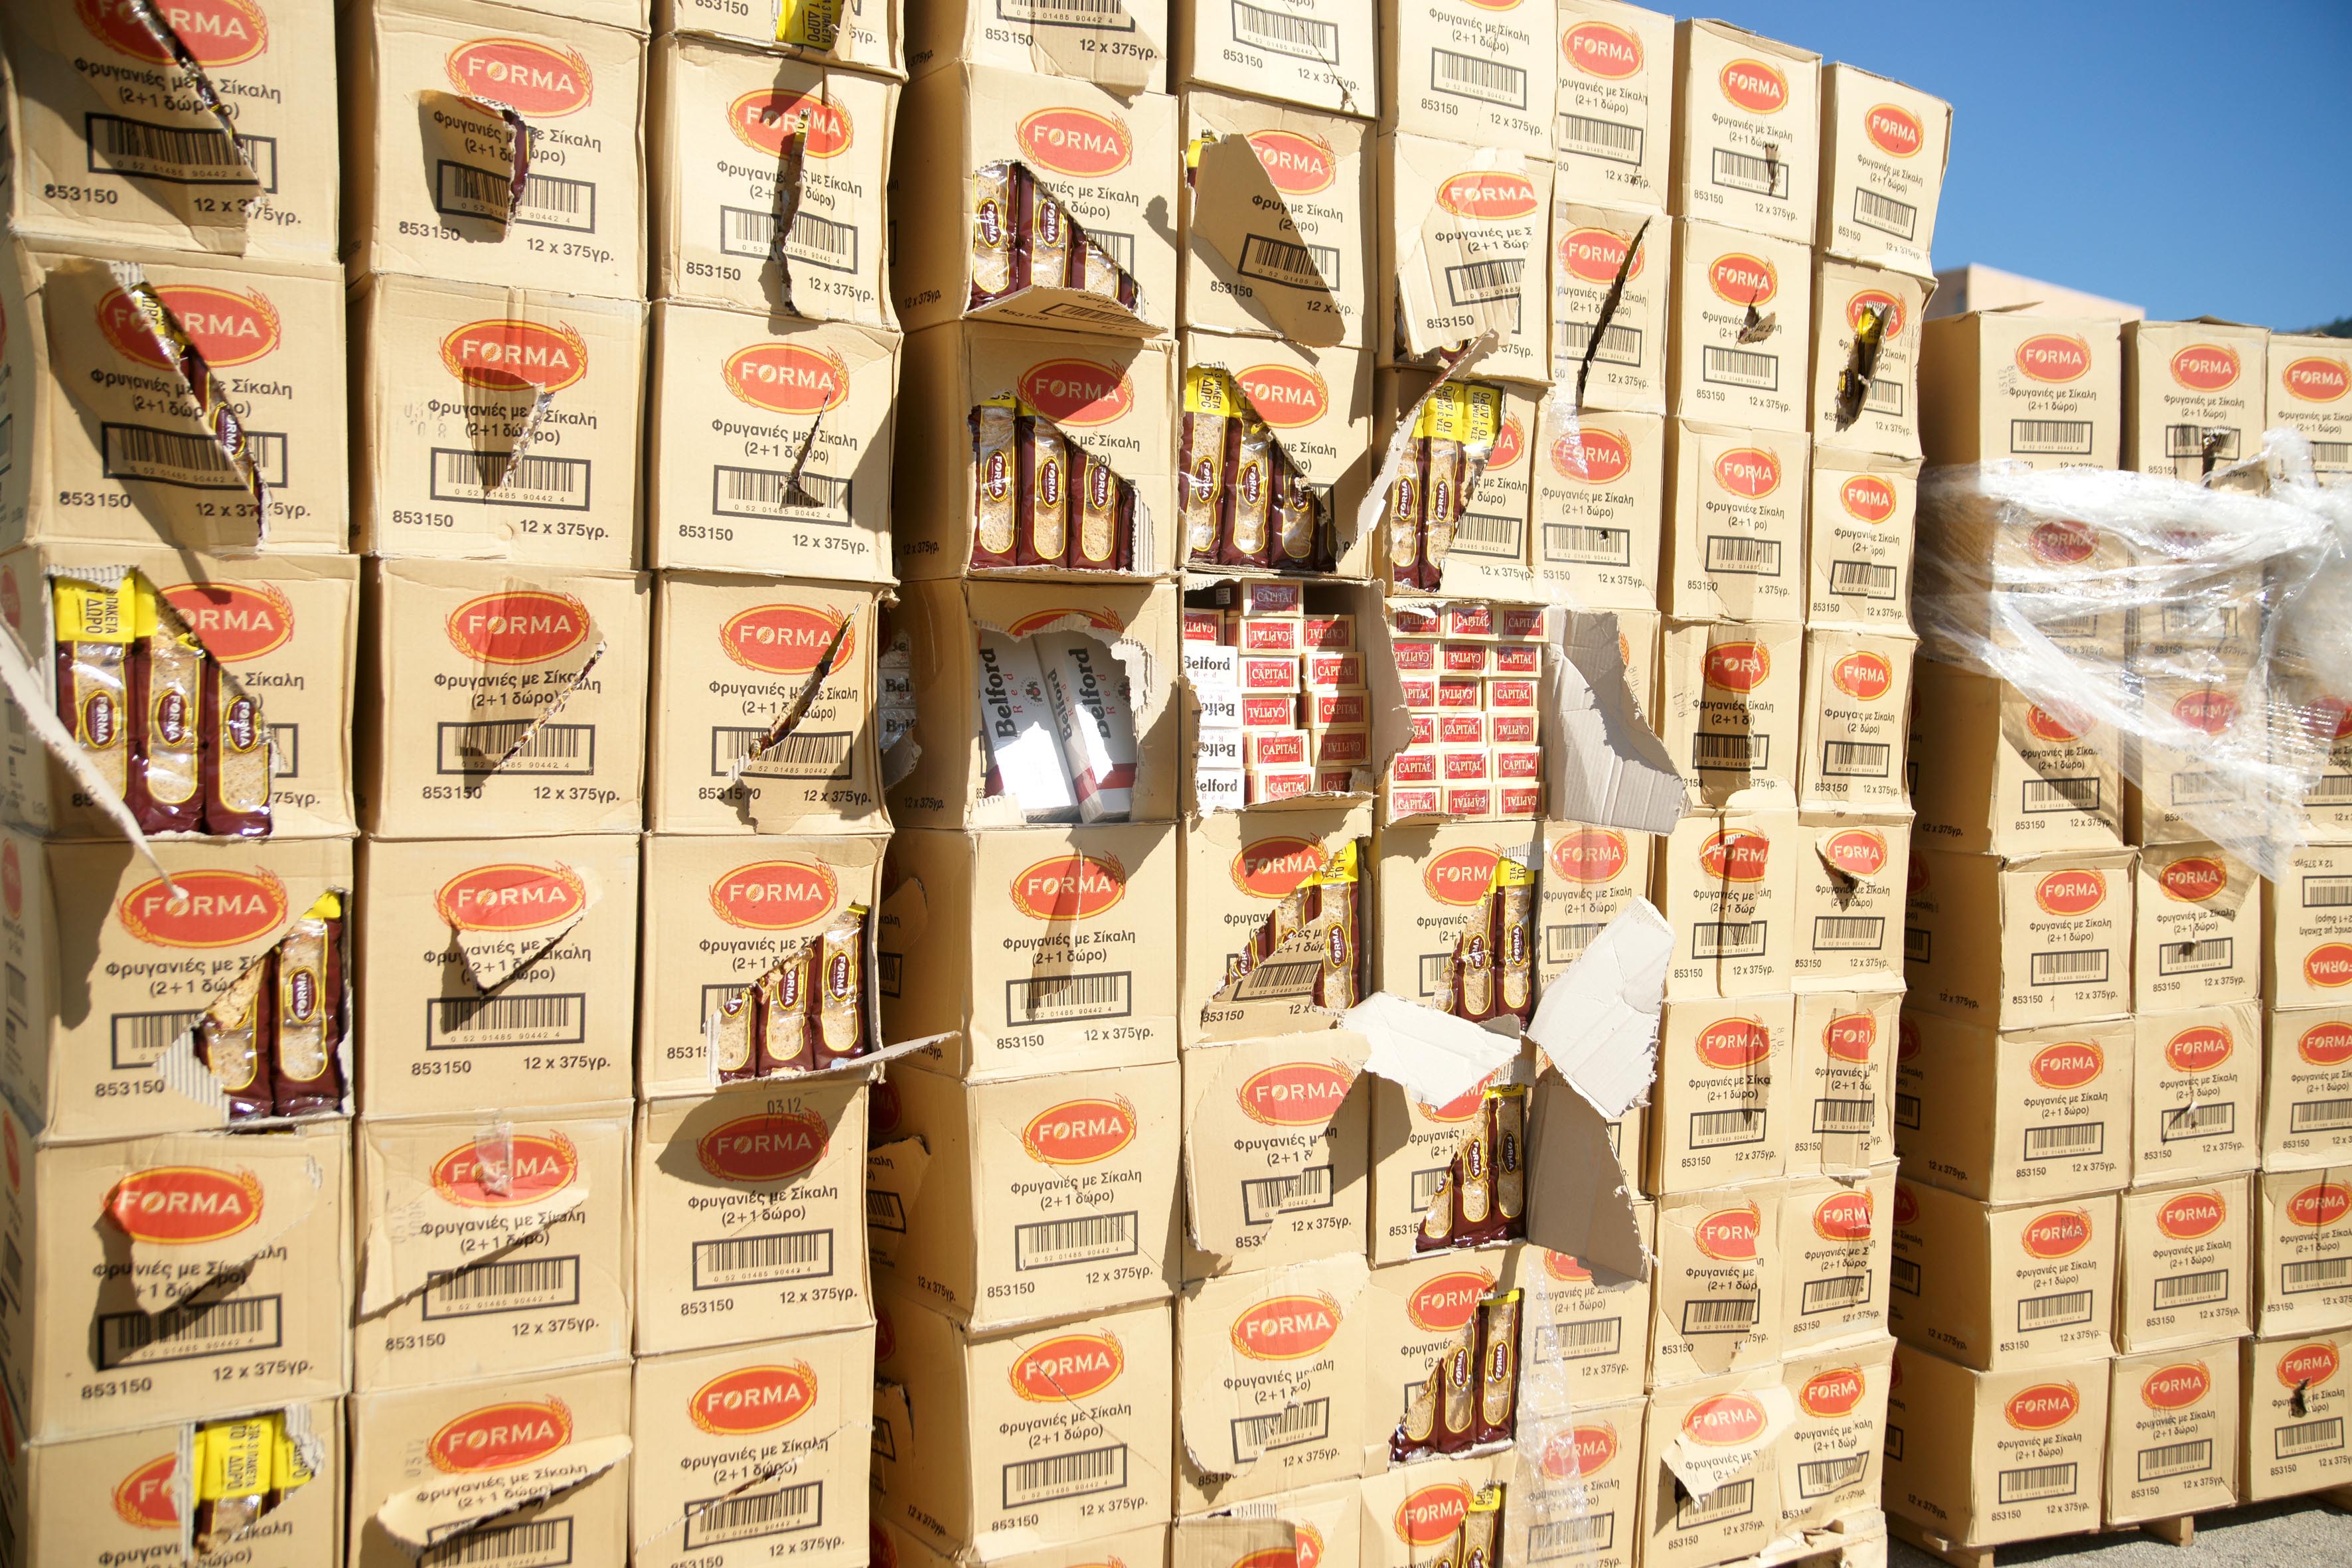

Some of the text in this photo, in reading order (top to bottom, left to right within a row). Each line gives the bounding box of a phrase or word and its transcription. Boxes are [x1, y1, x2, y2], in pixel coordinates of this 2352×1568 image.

[985, 27, 1034, 47] 853150
[1573, 37, 1634, 63] FORMA
[468, 57, 575, 94] FORMA
[1728, 71, 1780, 98] FORMA
[1421, 98, 1458, 116] 853150
[746, 106, 842, 137] FORMA
[1873, 114, 1917, 143] FORMA
[1034, 125, 1121, 155] FORMA
[1857, 154, 1922, 187] Φρυγανιές με Σίκαλη
[1870, 172, 1907, 195] (2+1 δώρο)
[44, 183, 118, 204] 853150
[1451, 187, 1533, 200] FORMA
[1694, 190, 1723, 204] 853150
[398, 222, 460, 241] 853150
[986, 202, 996, 244] FORMA
[1839, 226, 1861, 242] 853150
[527, 238, 614, 262] 12 x 375γρ.
[686, 262, 741, 281] 853150
[1718, 266, 1769, 290] FORMA
[463, 339, 570, 368] FORMA
[2026, 349, 2082, 365] FORMA
[2180, 358, 2232, 374] FORMA
[741, 362, 836, 390] FORMA
[2292, 368, 2343, 386] FORMA
[1036, 378, 1120, 403] FORMA
[2009, 386, 2096, 402] Φρυγανιές με Σίκαλη
[1480, 392, 1490, 418] ΔΩΡΟ
[2028, 400, 2077, 412] (2+1 δώρο)
[1478, 430, 1487, 441] ΤΟ
[1563, 444, 1621, 464] FORMA
[994, 454, 1002, 497] FORMA
[59, 491, 131, 508] 853150
[393, 510, 453, 527] 853150
[679, 524, 734, 541] 853150
[1257, 591, 1294, 603] CAPITAL
[86, 598, 103, 634] ΔΩΡΟ
[105, 597, 118, 634] ΠΑΚΕΤΑ
[1456, 615, 1490, 626] CAPITAL
[1508, 617, 1539, 627] CAPITAL
[469, 615, 572, 635] FORMA
[1251, 631, 1291, 641] CAPITAL
[1449, 653, 1481, 662] CAPITAL
[245, 672, 304, 689] Σίκαλη
[1252, 668, 1289, 679] CAPITAL
[979, 648, 1017, 738] Belford
[1004, 673, 1023, 714] Red
[1497, 690, 1529, 699] CAPITAL
[1048, 668, 1072, 741] Belford
[1247, 707, 1285, 717] CAPITAL
[1324, 704, 1359, 714] CAPITAL
[96, 696, 108, 744] FORMA
[1498, 725, 1529, 734] CAPITAL
[1263, 744, 1298, 755] CAPITAL
[1398, 763, 1432, 772] CAPITAL
[1503, 759, 1535, 769] CAPITAL
[422, 786, 482, 799] 853150
[2015, 821, 2045, 830] 853150
[1562, 848, 1621, 862] FORMA
[1245, 856, 1317, 877] FORMA
[1028, 876, 1112, 896] FORMA
[2167, 870, 2219, 886] FORMA
[458, 886, 566, 907] FORMA
[730, 883, 823, 903] FORMA
[2045, 882, 2098, 898] FORMA
[144, 895, 267, 917] FORMA
[1003, 929, 1135, 951] Φρυγανιές με Σίκαλη
[1032, 948, 1107, 967] (2+1 δώρο)
[837, 956, 846, 996] FORMA
[1674, 969, 1703, 979] 853150
[296, 972, 307, 1017] FORMA
[2012, 994, 2043, 1004] 853150
[997, 1034, 1044, 1050] 853150
[1084, 1026, 1154, 1041] 12 x 375γρ.
[1707, 1034, 1764, 1050] FORMA
[2174, 1040, 2225, 1056] FORMA
[412, 1061, 471, 1075] 853150
[524, 1056, 610, 1071] 12 x 375γρ.
[2041, 1056, 2094, 1072] FORMA
[95, 1079, 165, 1097] 853150
[1256, 1081, 1344, 1102] FORMA
[2023, 1093, 2108, 1107] Φρυγανιές με Σίκαλη
[2041, 1106, 2089, 1119] (2+1 δώρο)
[1038, 1116, 1124, 1142] FORMA
[718, 1133, 813, 1155] FORMA
[1682, 1156, 1711, 1168] 853150
[2090, 1162, 2116, 1172] 375γρ.
[2016, 1167, 2047, 1178] 853150
[1011, 1169, 1142, 1196] Φρυγανιές με Σίκαλη
[119, 1191, 242, 1215] FORMA
[688, 1185, 838, 1210] Φρυγανιές με Σίκαλη
[1040, 1192, 1115, 1211] (2+1 δώρο)
[2296, 1195, 2345, 1211] FORMA
[722, 1208, 806, 1227] (2+1 δώρο)
[2166, 1206, 2217, 1223] FORMA
[2031, 1227, 2082, 1242] FORMA
[779, 1287, 857, 1304] 12 x 375γρ.
[917, 1275, 925, 1287] 12
[933, 1283, 956, 1301] 375γρ.
[988, 1282, 1035, 1298] 853150
[680, 1298, 734, 1316] 853150
[1420, 1290, 1484, 1310] FORMA
[1246, 1311, 1330, 1339] FORMA
[2146, 1316, 2175, 1327] 853150
[385, 1333, 446, 1351] 853150
[2000, 1340, 2029, 1352] 853150
[1026, 1352, 1110, 1380] FORMA
[2285, 1356, 2331, 1372] FORMA
[81, 1377, 152, 1399] 853150
[1808, 1379, 1857, 1401] FORMA
[2151, 1377, 2202, 1395] FORMA
[707, 1383, 802, 1412] FORMA
[2015, 1397, 2070, 1413] FORMA
[1693, 1409, 1758, 1428] FORMA
[449, 1421, 554, 1451] FORMA
[2270, 1464, 2297, 1475] 853150
[1992, 1510, 2021, 1521] 853150
